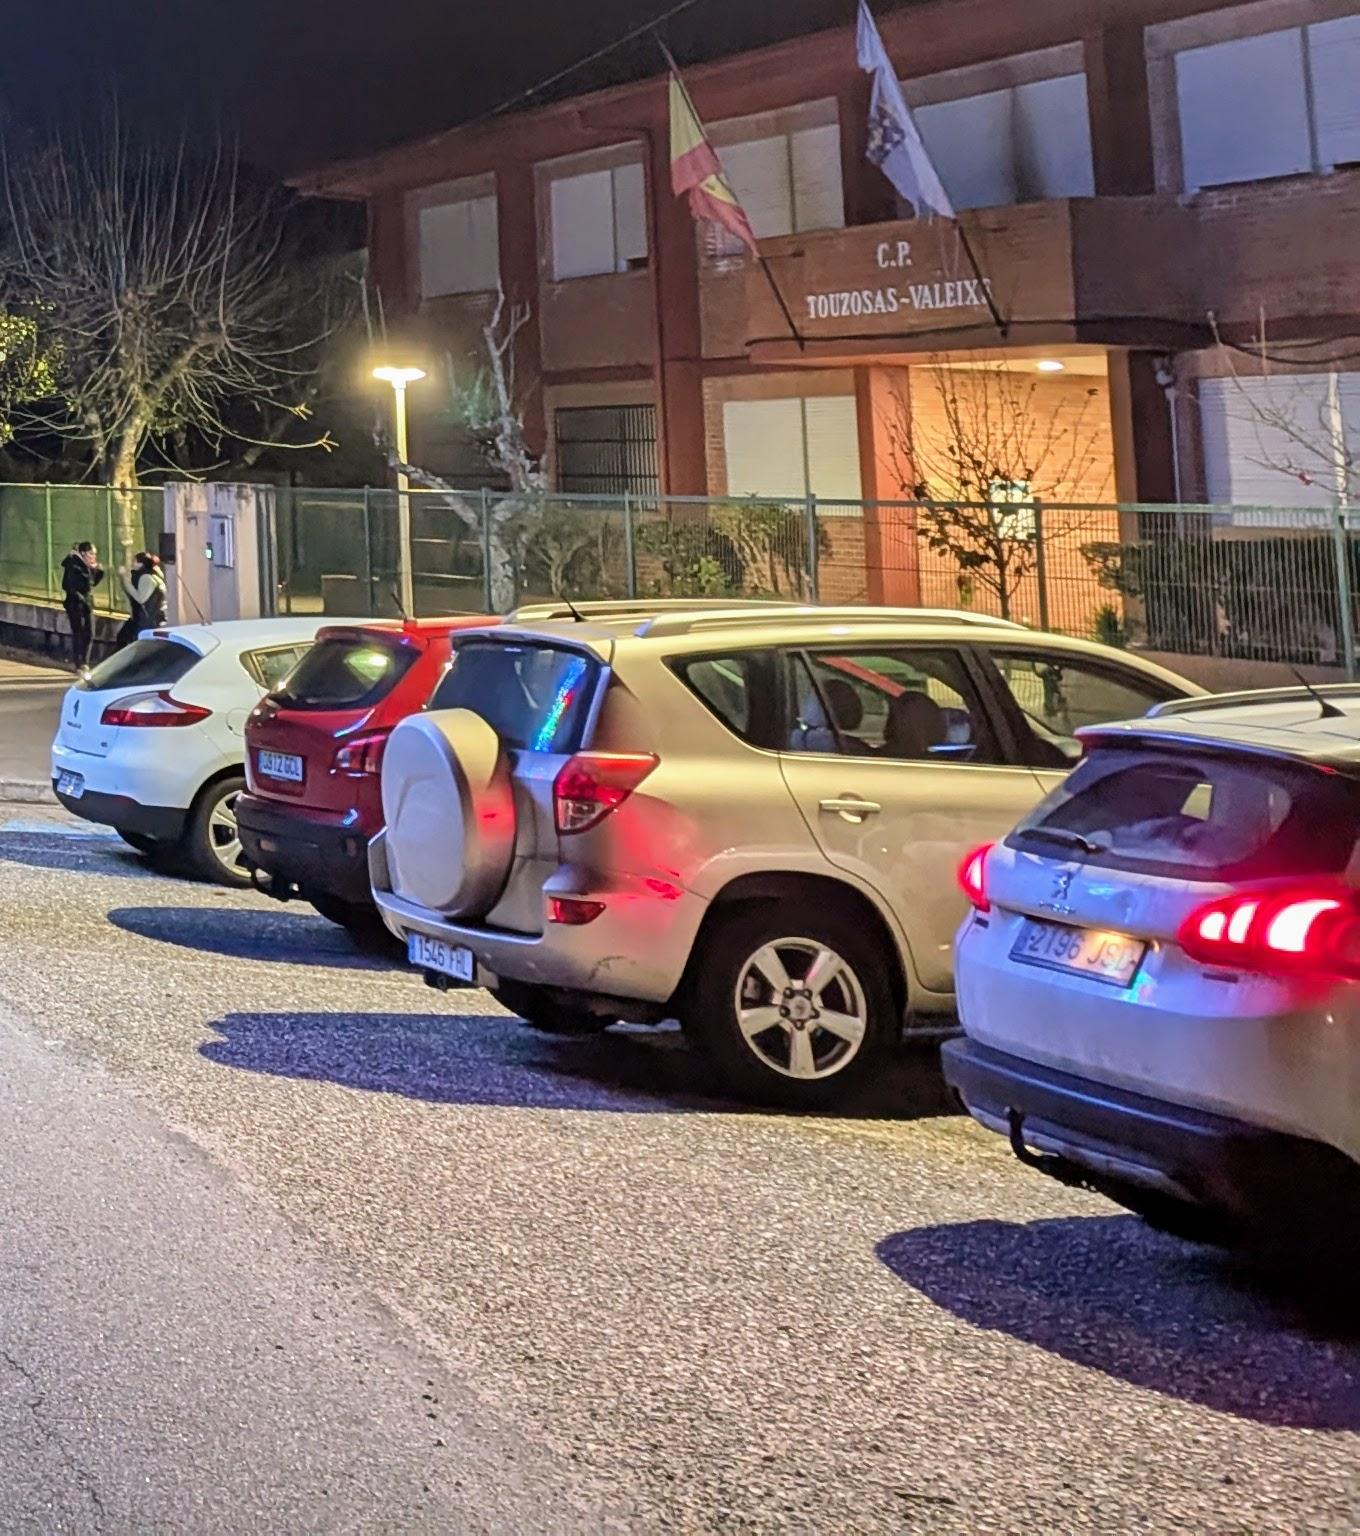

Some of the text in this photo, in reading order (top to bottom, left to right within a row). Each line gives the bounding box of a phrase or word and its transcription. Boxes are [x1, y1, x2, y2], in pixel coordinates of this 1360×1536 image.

[877, 241, 912, 268] C.P.
[419, 937, 445, 967] 1546
[1028, 926, 1085, 960] 2196
